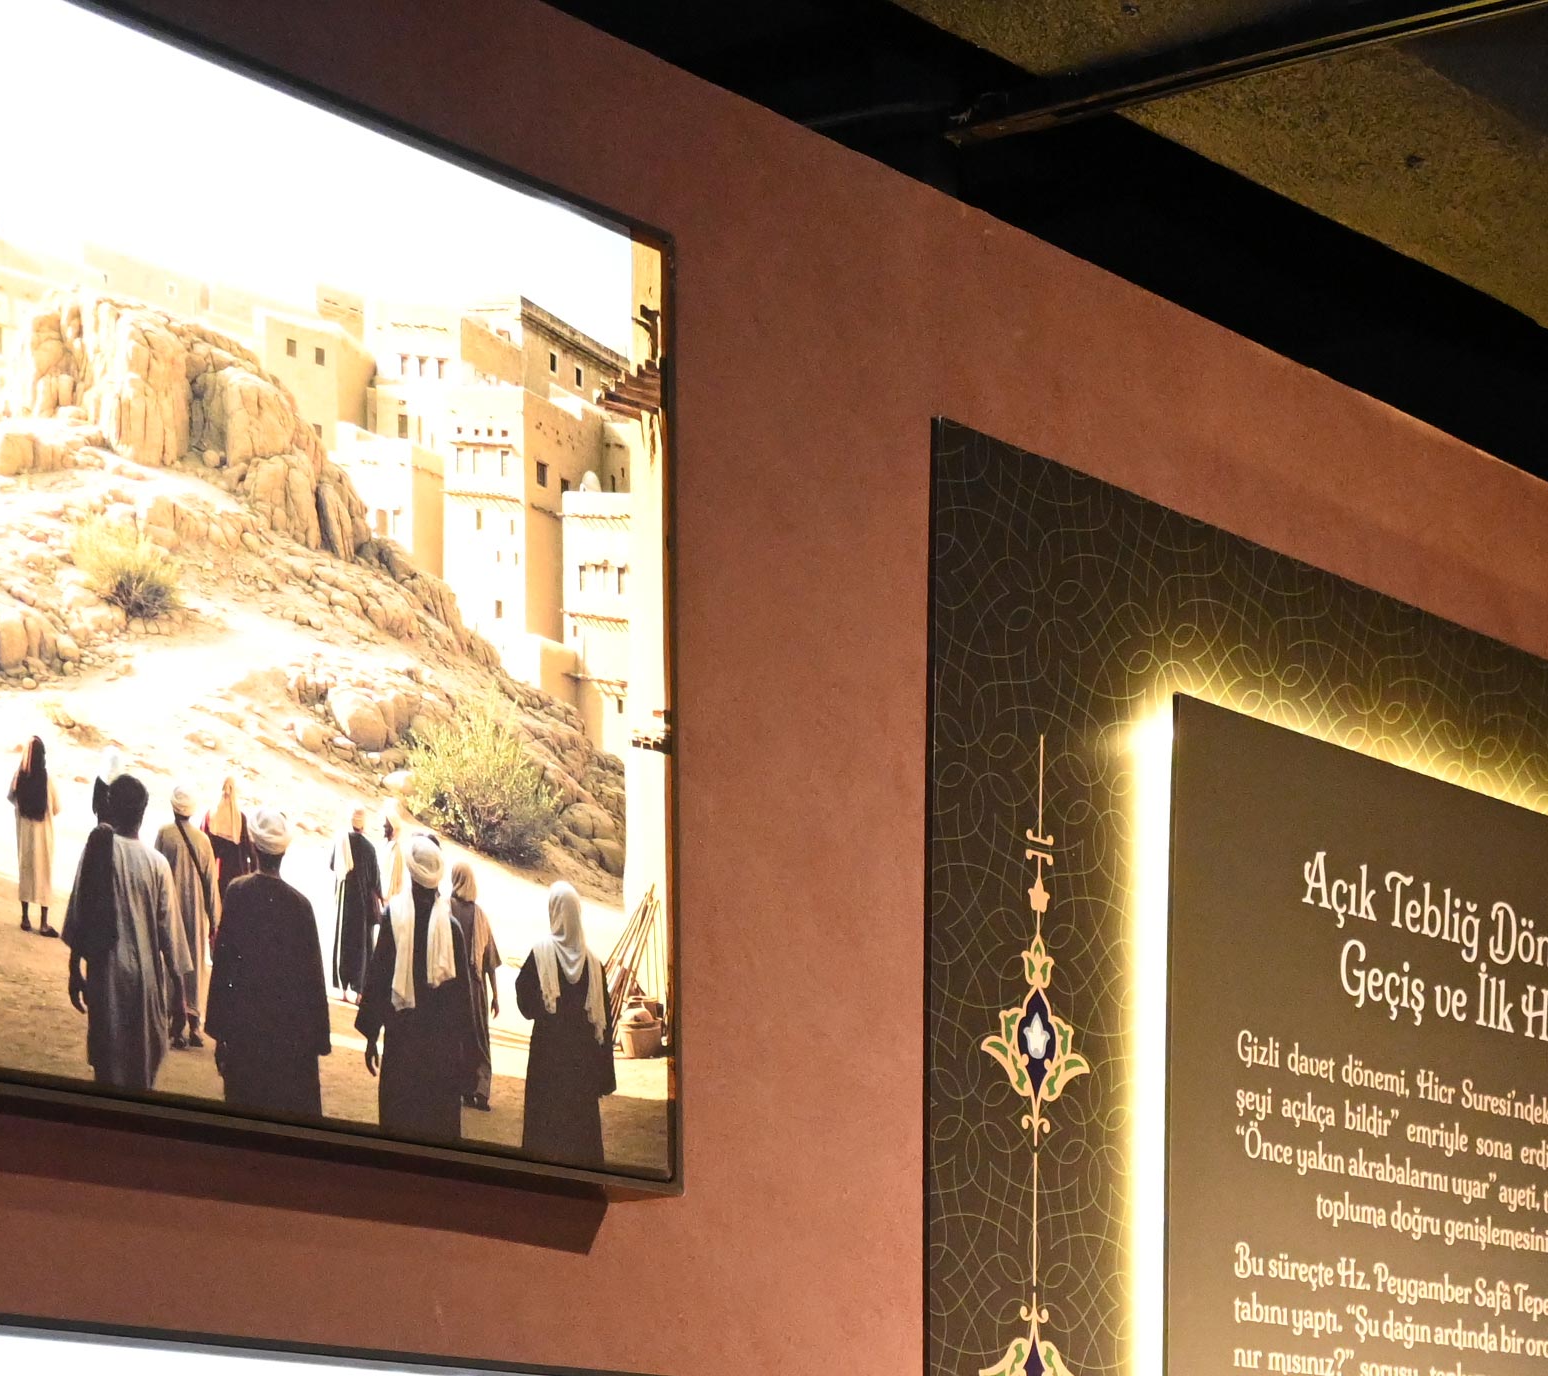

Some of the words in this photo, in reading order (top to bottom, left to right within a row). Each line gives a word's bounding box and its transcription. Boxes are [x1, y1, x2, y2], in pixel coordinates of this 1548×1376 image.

[1302, 852, 1377, 928] Açık
[1385, 871, 1480, 963] Tebliğ
[1341, 939, 1424, 1026] Geçiş
[1435, 985, 1467, 1021] ve
[1476, 961, 1514, 1033] İlk
[1238, 1030, 1279, 1068] Gizli
[1288, 1042, 1335, 1083] davet
[1342, 1054, 1409, 1098] dönemi,
[1417, 1069, 1455, 1104] Hicr
[1236, 1088, 1272, 1120] şeyi
[1282, 1092, 1335, 1132] açıkça
[1407, 1123, 1468, 1157] emriyle
[1476, 1138, 1512, 1160] sona
[1297, 1141, 1344, 1175] yakın
[1348, 1148, 1448, 1192] akrabalarını
[1499, 1185, 1540, 1212] ayeti,
[1317, 1192, 1386, 1228] topluma
[1391, 1201, 1440, 1240] doğru
[1445, 1216, 1548, 1252] genişlemesini
[1235, 1242, 1264, 1278] Bu
[1269, 1253, 1333, 1291] süreçte
[1337, 1257, 1370, 1290] Hz.
[1373, 1263, 1472, 1305] Peygamber
[1475, 1278, 1511, 1316] Safâ
[1234, 1292, 1288, 1325] tabını
[1292, 1309, 1342, 1338] yaptı.
[1383, 1310, 1431, 1349] dağın
[1434, 1319, 1497, 1353] ardında
[1501, 1325, 1524, 1353] bir
[1234, 1348, 1262, 1368] nır
